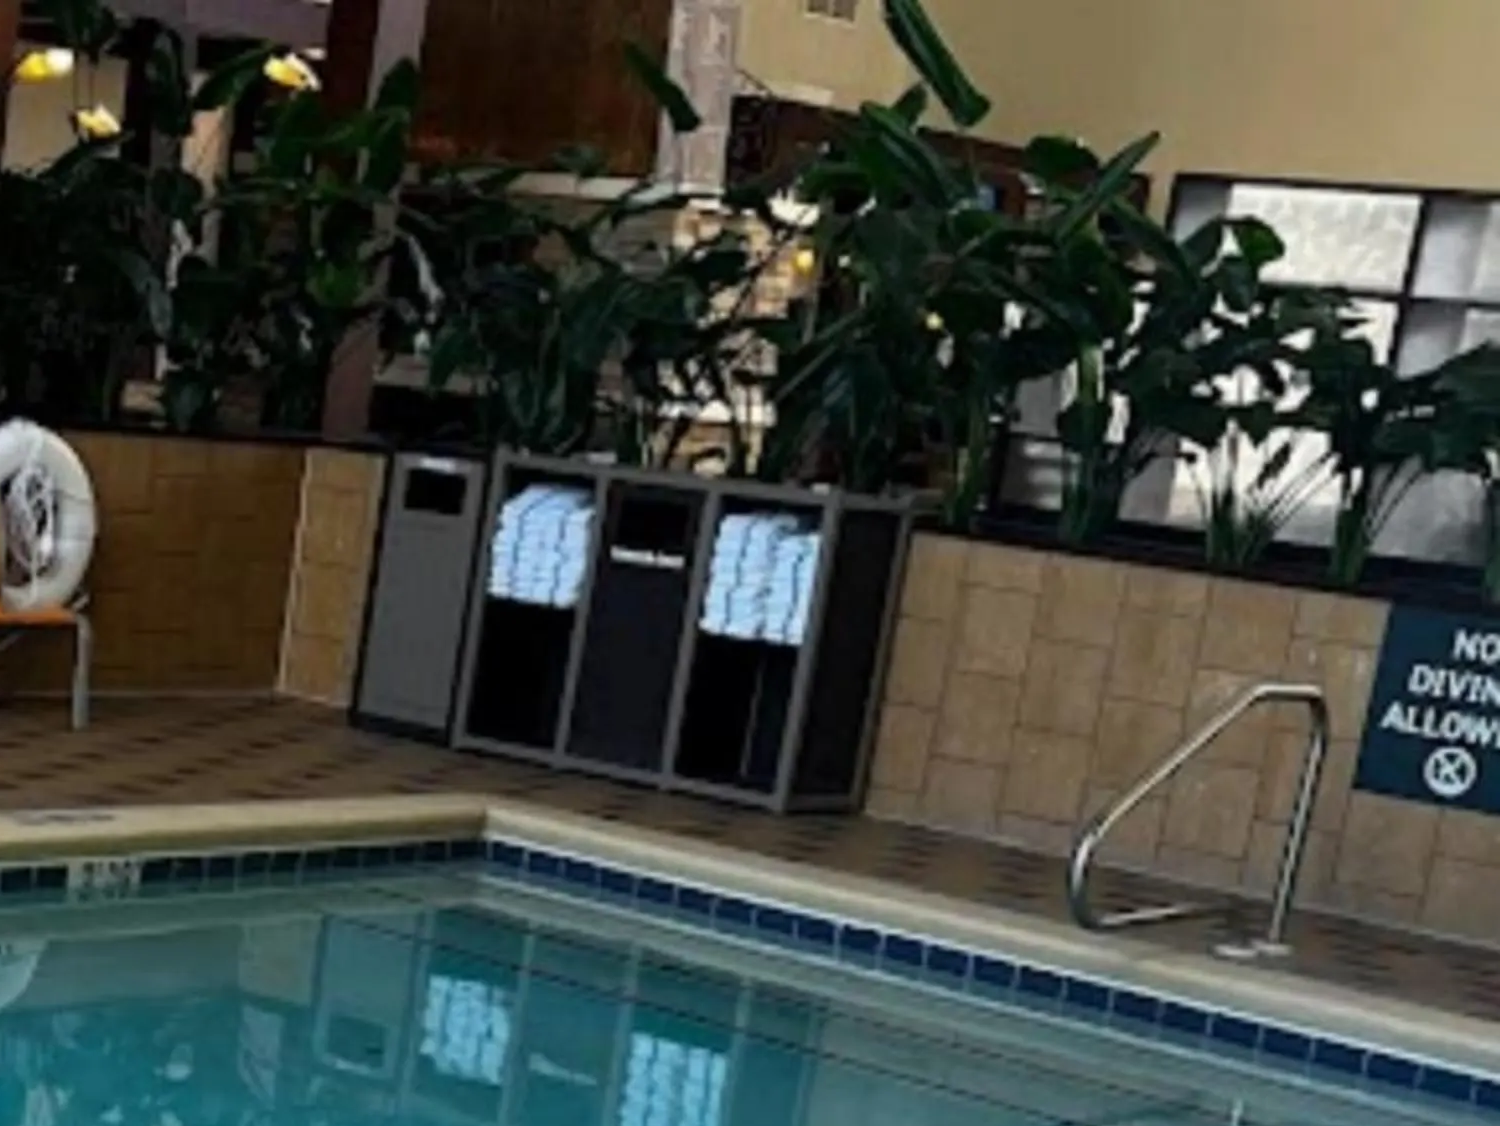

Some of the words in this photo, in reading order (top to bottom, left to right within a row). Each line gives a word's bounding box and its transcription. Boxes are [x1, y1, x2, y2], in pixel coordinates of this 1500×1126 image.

[1453, 628, 1500, 664] NO
[1408, 663, 1500, 707] DIVIN
[1379, 700, 1500, 748] ALLOW
